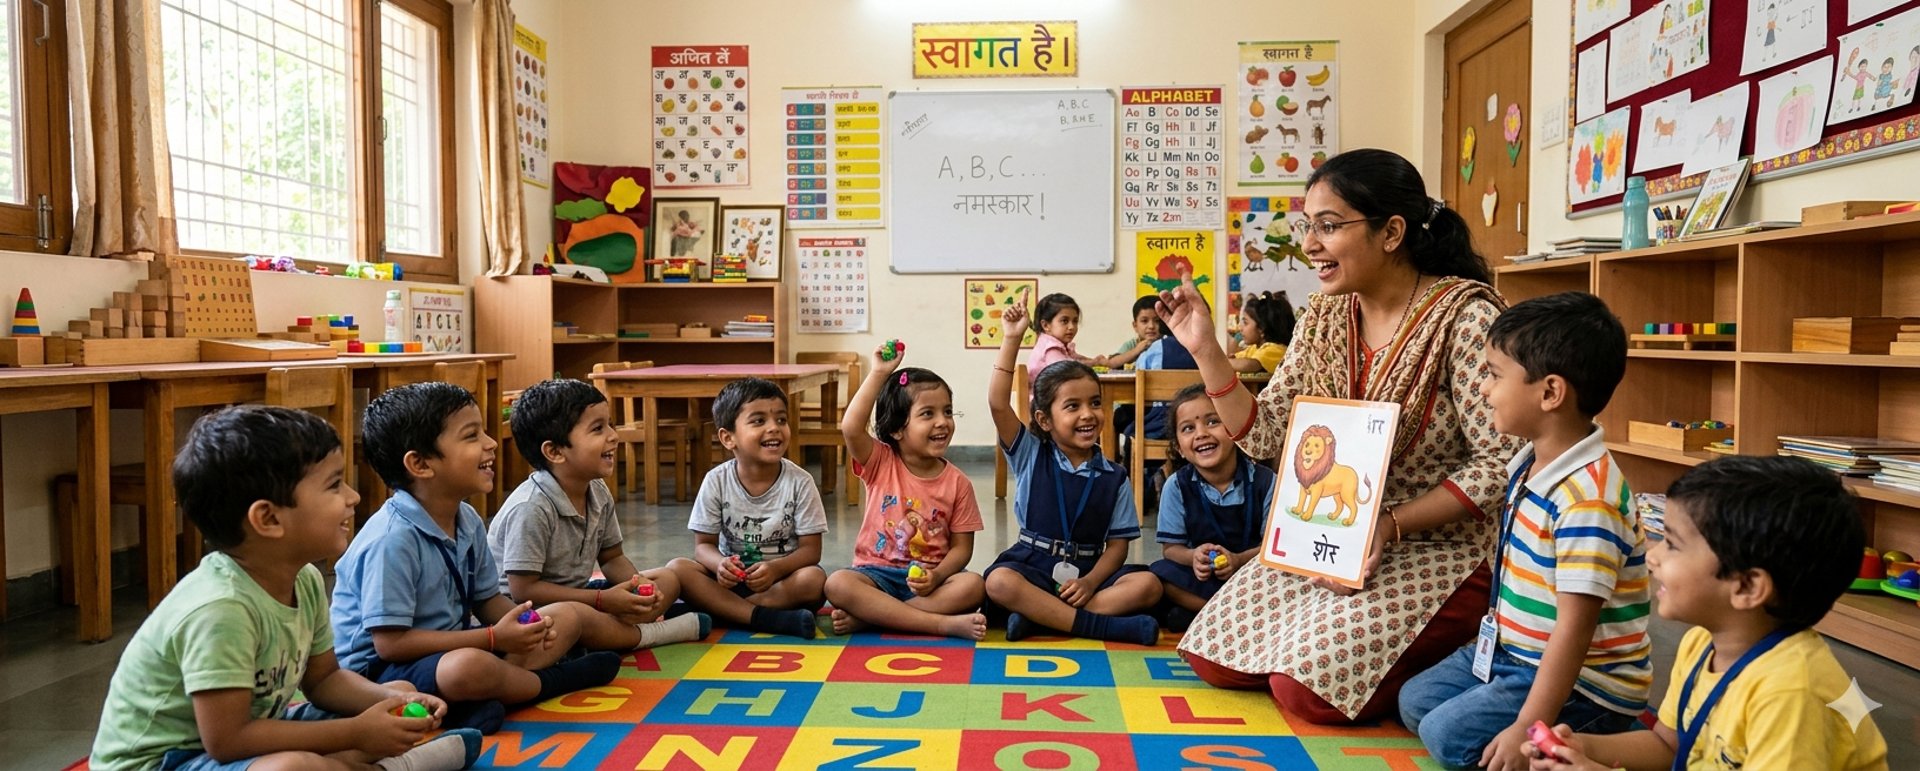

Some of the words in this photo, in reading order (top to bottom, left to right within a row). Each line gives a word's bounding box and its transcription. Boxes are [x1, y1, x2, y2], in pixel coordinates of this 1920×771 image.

[919, 37, 1021, 69] स्वागत
[1130, 90, 1214, 103] ALPHABET
[1186, 106, 1199, 117] Dd
[1146, 122, 1159, 134] Gg
[1166, 122, 1179, 131] Hh
[1146, 137, 1159, 149] Gg
[1166, 137, 1179, 147] Hh
[1125, 152, 1139, 162] Kk
[1164, 152, 1181, 161] Mm
[1186, 152, 1199, 161] Nn
[1205, 152, 1219, 162] Oo
[1125, 168, 1139, 177] Oo
[1146, 167, 1159, 179] Pp
[1147, 182, 1159, 192] Rr
[1126, 198, 1139, 207] Uu
[1126, 212, 1138, 224] Yy
[1271, 527, 1286, 557] L
[1313, 533, 1340, 564] शेर
[723, 650, 803, 673] B
[864, 652, 943, 676] C
[1005, 654, 1081, 678] D
[1144, 657, 1201, 681] E
[534, 686, 634, 713] G
[684, 688, 787, 716] H
[851, 690, 926, 718] J
[1001, 692, 1096, 722] K
[1160, 696, 1247, 725] L
[480, 732, 597, 768] M
[633, 734, 759, 771] N
[816, 738, 922, 771] Z
[994, 741, 1101, 771] O
